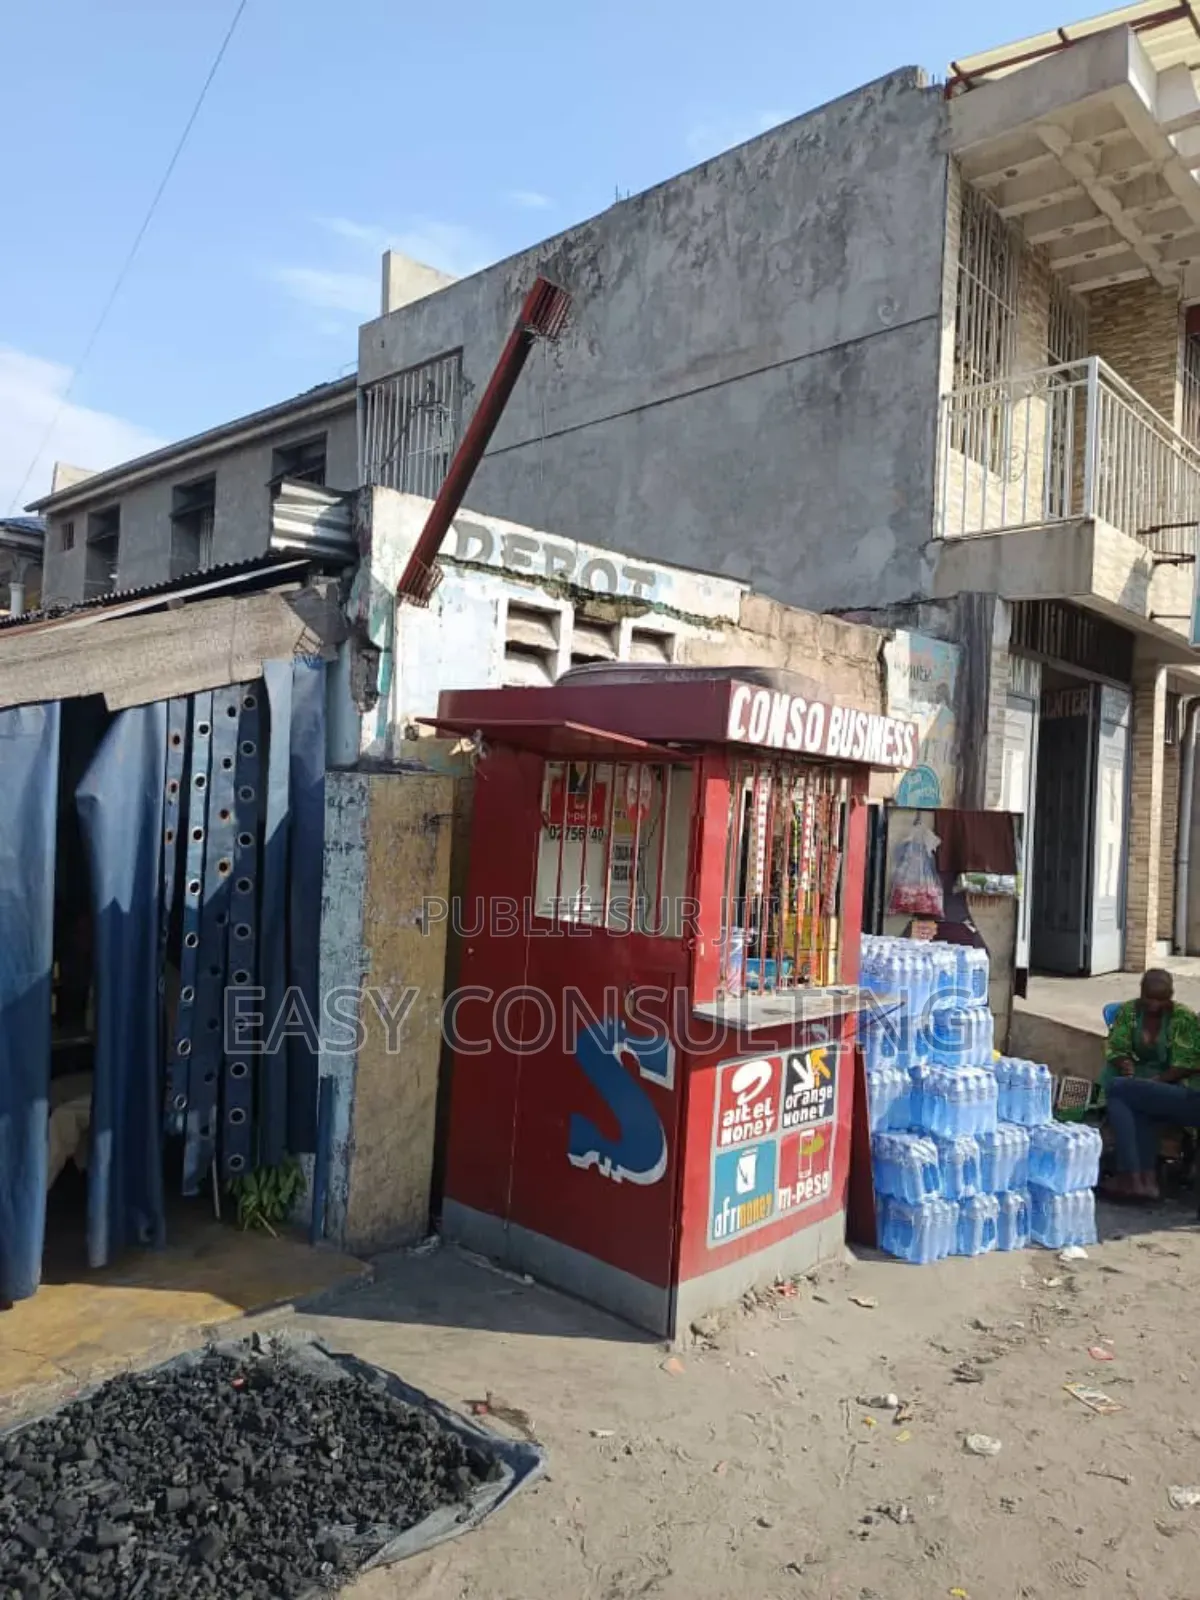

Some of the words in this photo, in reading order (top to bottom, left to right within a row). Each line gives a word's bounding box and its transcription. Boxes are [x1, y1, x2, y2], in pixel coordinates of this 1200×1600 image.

[452, 520, 656, 598] DEPOT
[727, 686, 825, 753] CONSO
[826, 706, 915, 768] BUSINESS
[785, 1085, 833, 1110] orange
